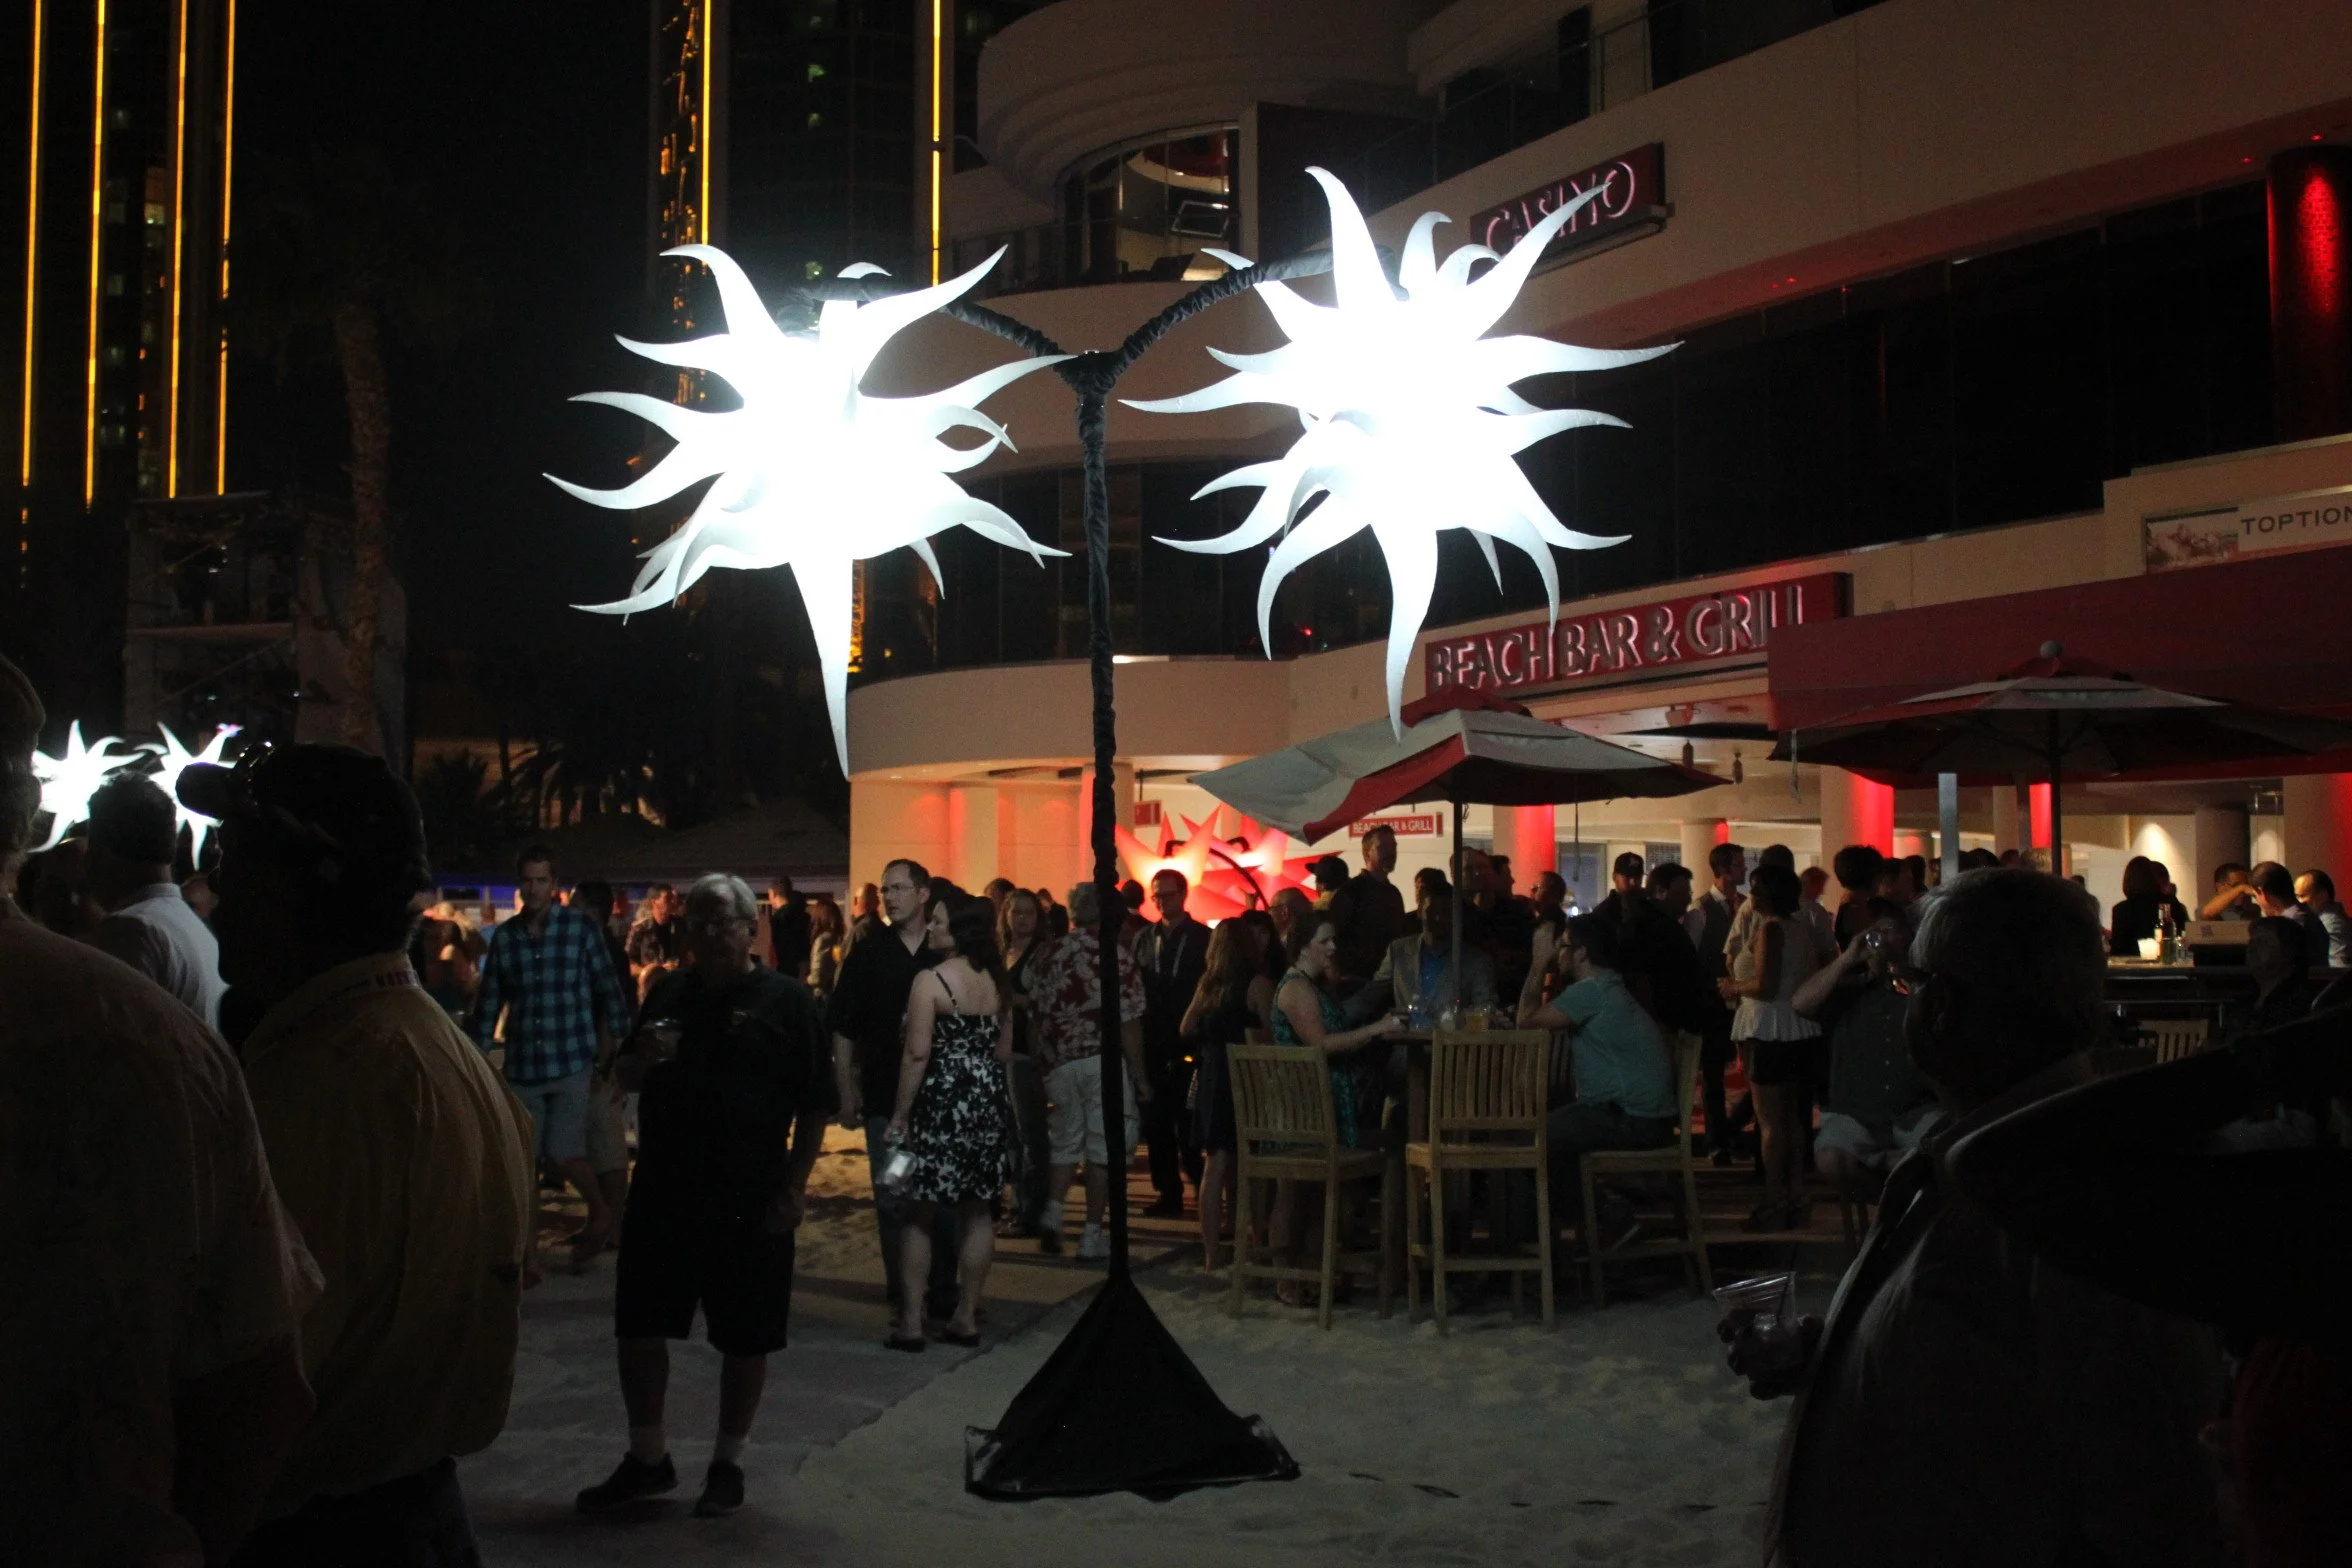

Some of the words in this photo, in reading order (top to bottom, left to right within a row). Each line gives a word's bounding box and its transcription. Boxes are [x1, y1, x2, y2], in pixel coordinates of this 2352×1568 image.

[1432, 626, 1556, 690] BEACH
[1558, 613, 1643, 677] BAR
[1645, 606, 1682, 663] &
[1408, 819, 1433, 832] GRILL
